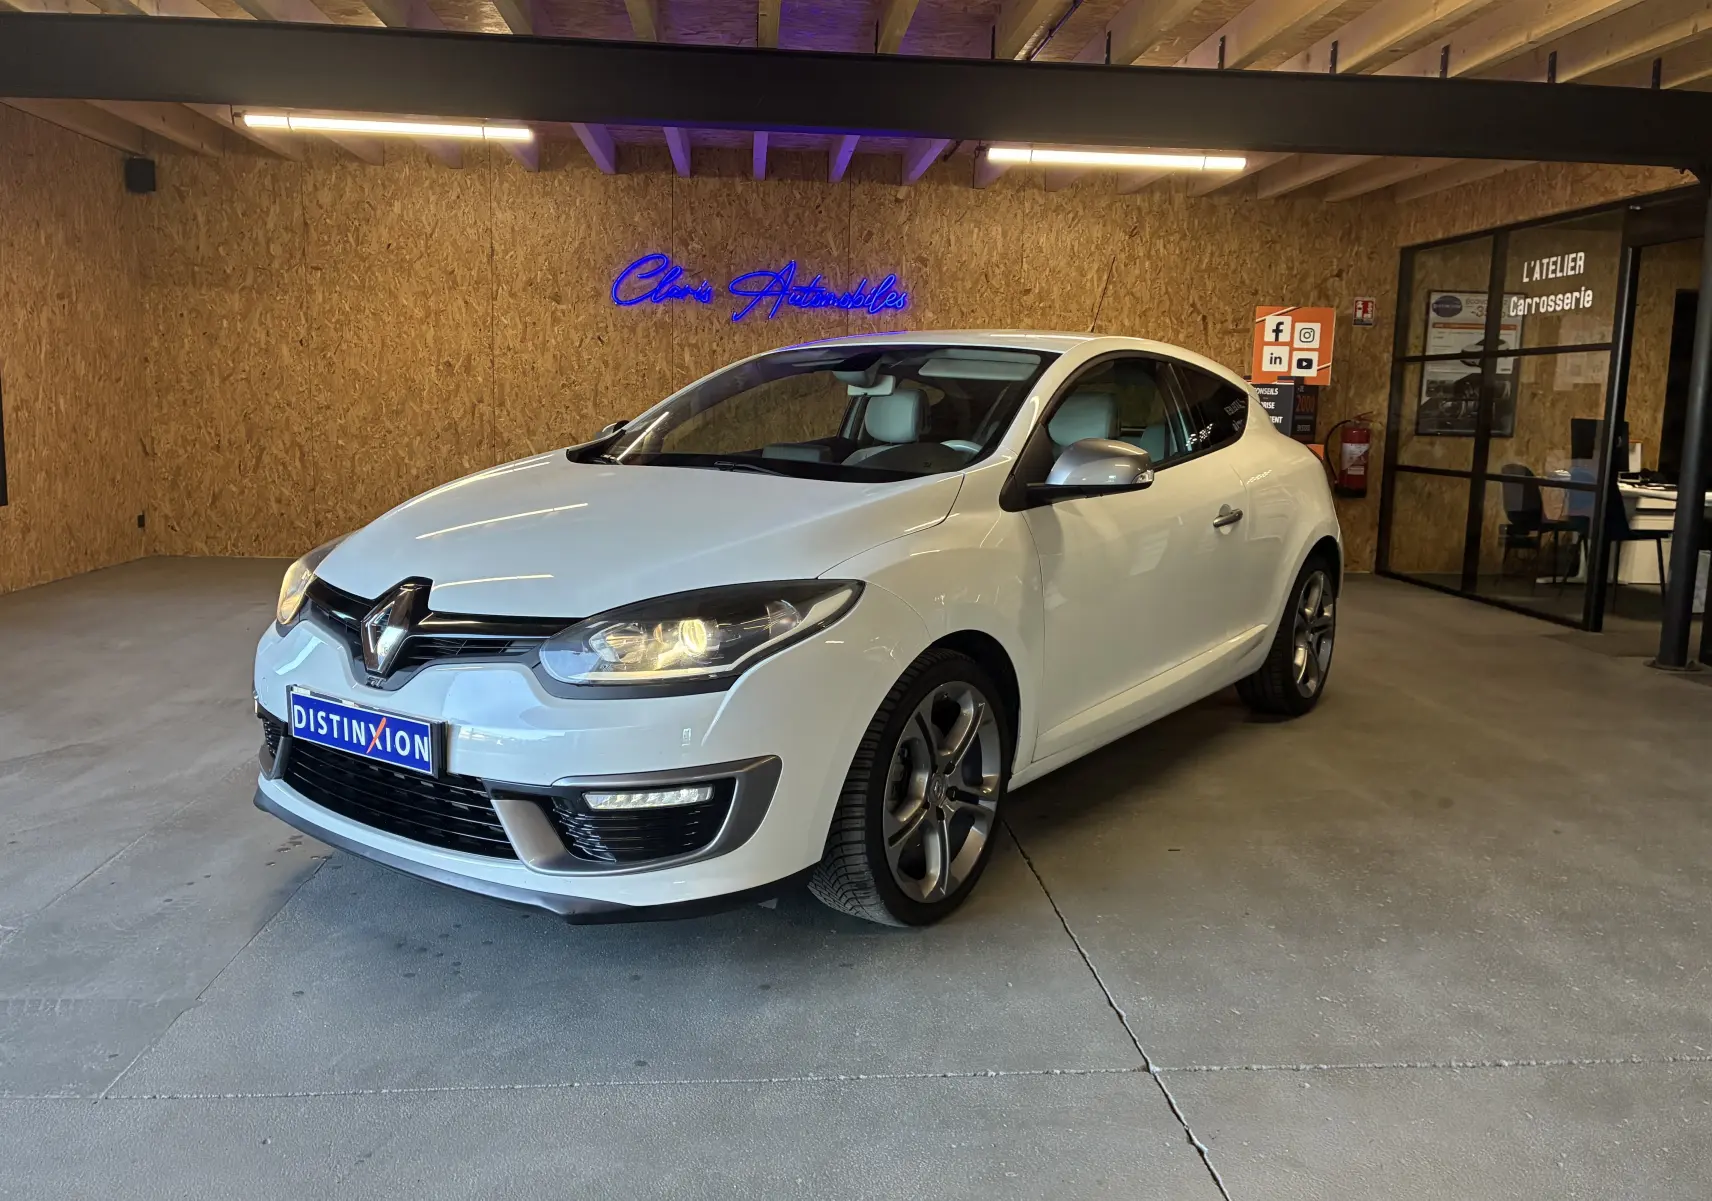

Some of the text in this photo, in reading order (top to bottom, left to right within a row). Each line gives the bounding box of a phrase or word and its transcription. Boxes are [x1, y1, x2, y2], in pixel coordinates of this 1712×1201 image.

[1522, 251, 1585, 282] L'ATELIER
[728, 259, 907, 322] Automobiles
[1509, 286, 1593, 317] Carrosserie
[1269, 352, 1282, 365] in
[1254, 387, 1279, 395] ONSEILS
[293, 704, 429, 762] DISTINXION
